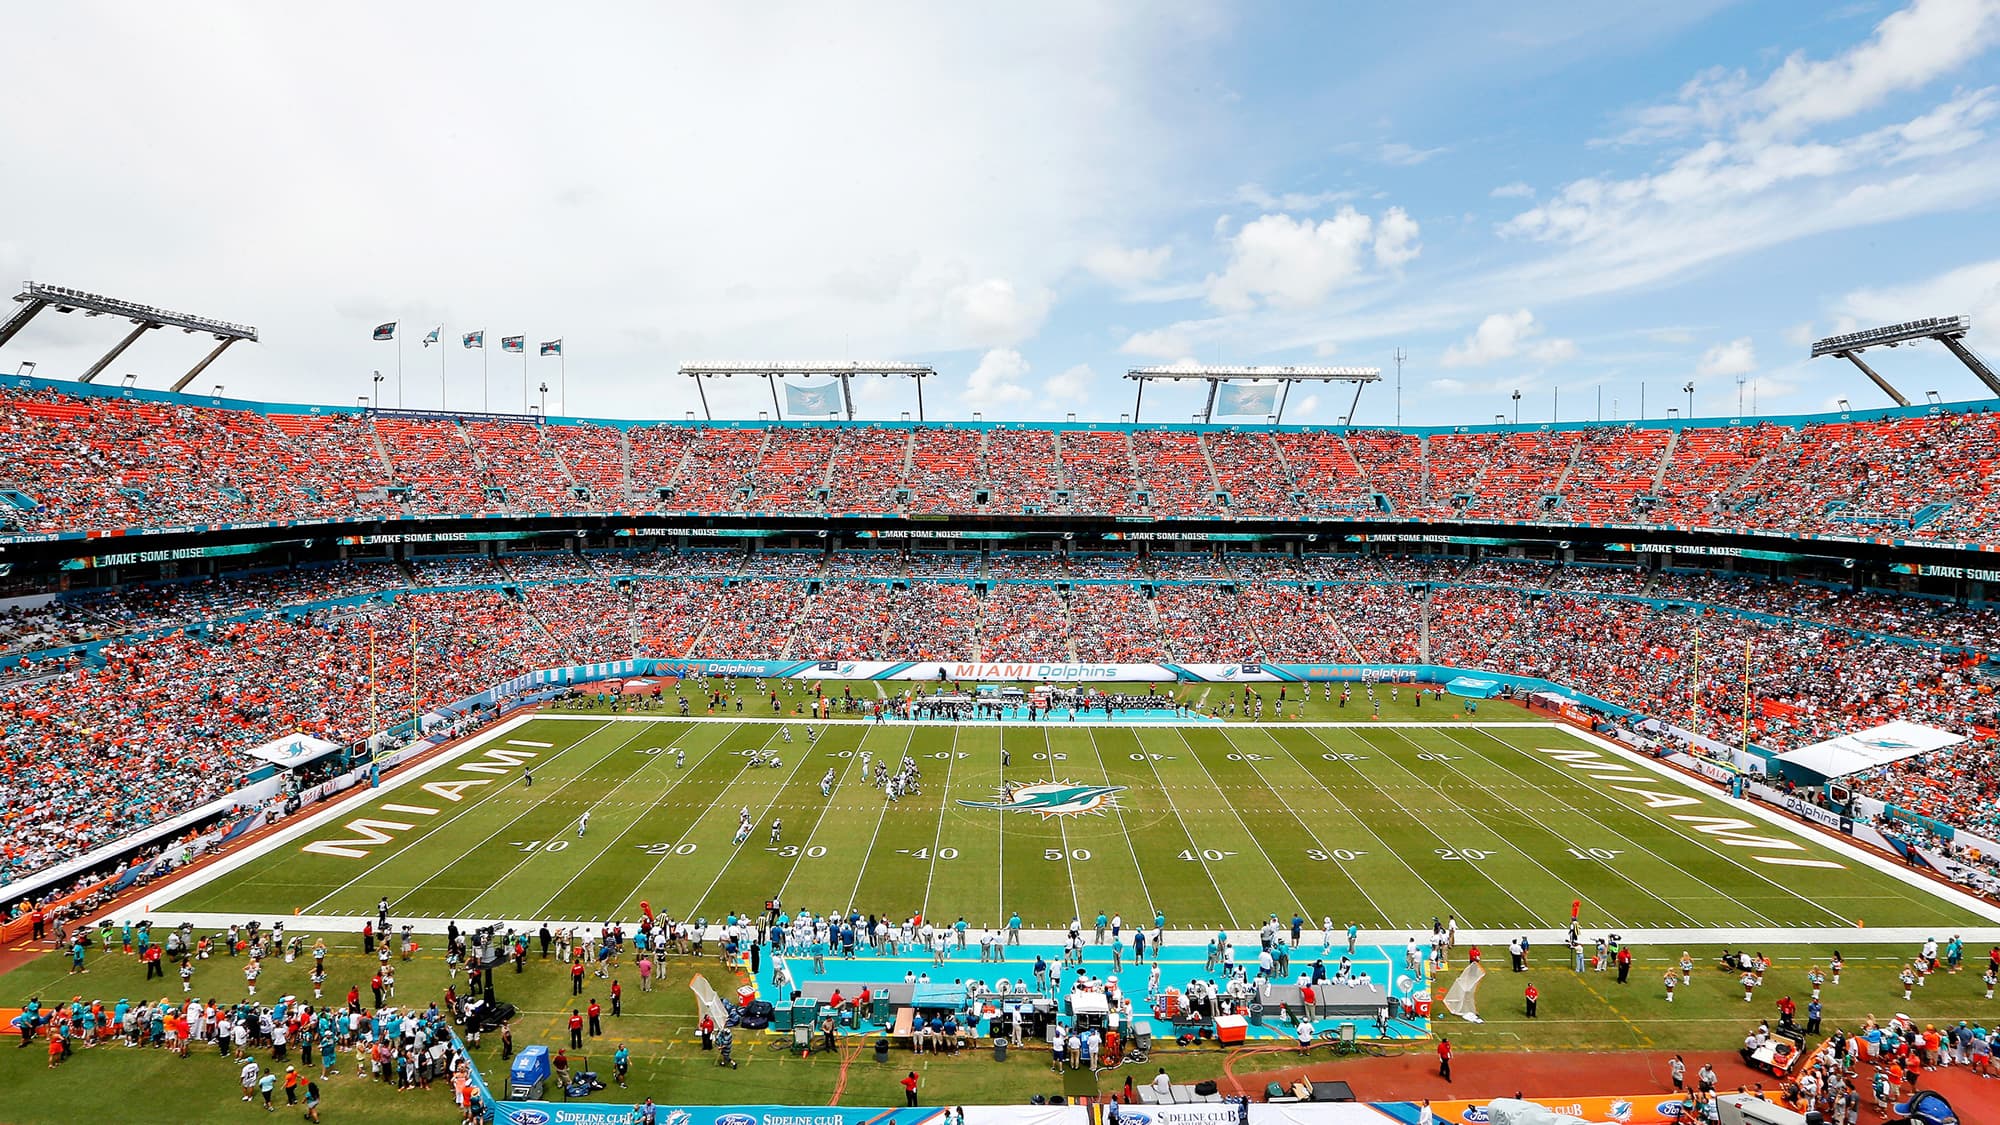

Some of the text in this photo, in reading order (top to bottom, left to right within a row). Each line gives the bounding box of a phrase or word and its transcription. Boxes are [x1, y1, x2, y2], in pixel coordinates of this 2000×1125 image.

[371, 534, 400, 543] MAKE
[404, 533, 432, 542] SOME
[644, 528, 666, 536] MAKE
[668, 528, 690, 536] SOME
[886, 530, 908, 538] MAKE
[910, 530, 933, 538] SOME
[1374, 534, 1396, 542] MAKE
[1399, 534, 1421, 542] SOME
[1642, 544, 1672, 553] MAKE
[1675, 545, 1705, 554] SOME
[105, 547, 204, 566] MAKE SOME NOISE!
[1930, 565, 2000, 582] MAKE SOME
[656, 662, 765, 674] MIAMI Dolphins
[955, 665, 1118, 680] MIAMI Dolphins
[1309, 668, 1417, 679] MIAMI Dolphins
[1322, 753, 1359, 761] 20
[1417, 753, 1452, 761] 10
[302, 739, 553, 858] MIAMI
[1536, 748, 1847, 869] MIAMI
[1786, 798, 1839, 827] Dolphins
[520, 840, 569, 853] 10
[646, 841, 697, 855] 20
[778, 844, 827, 858] 30
[906, 847, 959, 860] 40
[1043, 848, 1092, 861] 50
[1177, 848, 1225, 861] 40
[1306, 848, 1358, 861] 30
[1433, 847, 1486, 860] 20
[1565, 847, 1616, 860] 10
[1420, 1004, 1428, 1012] G
[555, 1110, 602, 1123] SIDELINE
[1555, 1104, 1583, 1116] CLUB
[723, 1114, 843, 1125] Ford SIDELINE CLUB
[1118, 1110, 1236, 1125] Ford SDELINE CLUB
